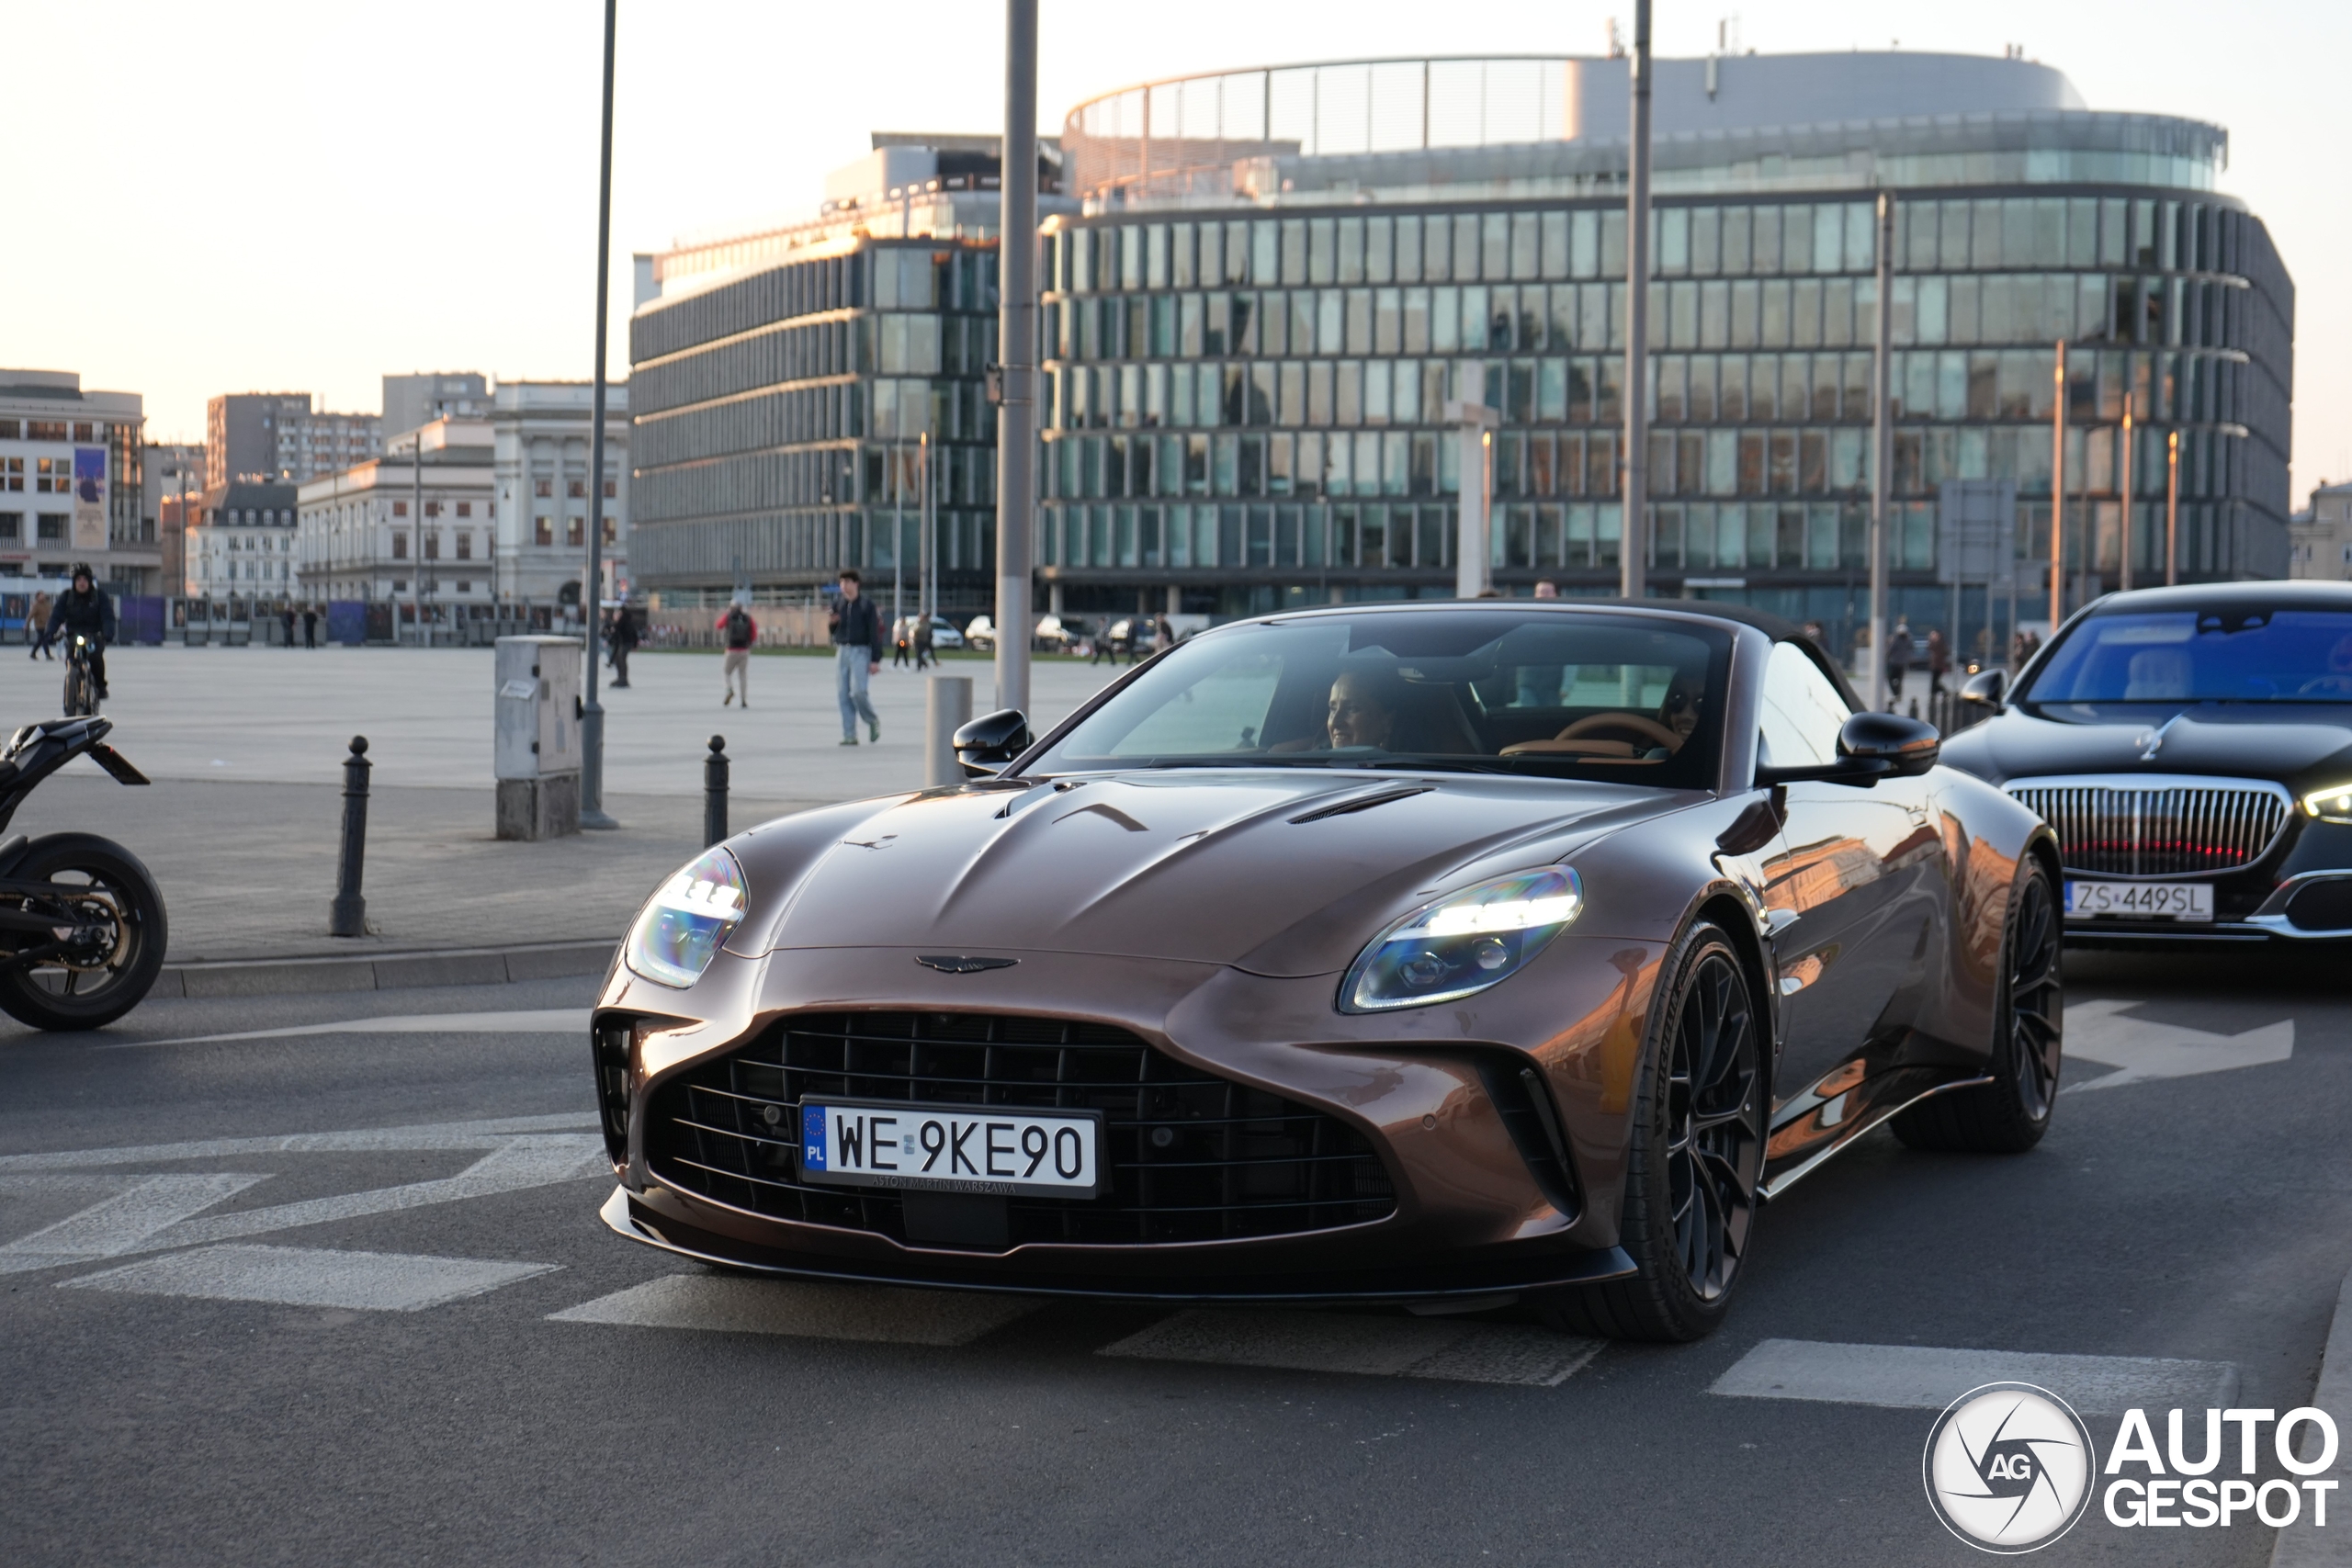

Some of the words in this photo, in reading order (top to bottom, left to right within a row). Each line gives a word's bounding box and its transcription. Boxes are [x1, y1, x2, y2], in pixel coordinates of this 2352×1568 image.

[2077, 886, 2111, 910] ZS
[2122, 886, 2205, 912] 449SL
[1657, 991, 1679, 1100] MICHELIN
[808, 1146, 824, 1161] PL
[836, 1114, 899, 1170] WE
[920, 1120, 1083, 1179] 9KE90
[873, 1176, 907, 1188] ASTON
[910, 1178, 951, 1190] MARTIN
[954, 1180, 1016, 1193] WARSZAWA
